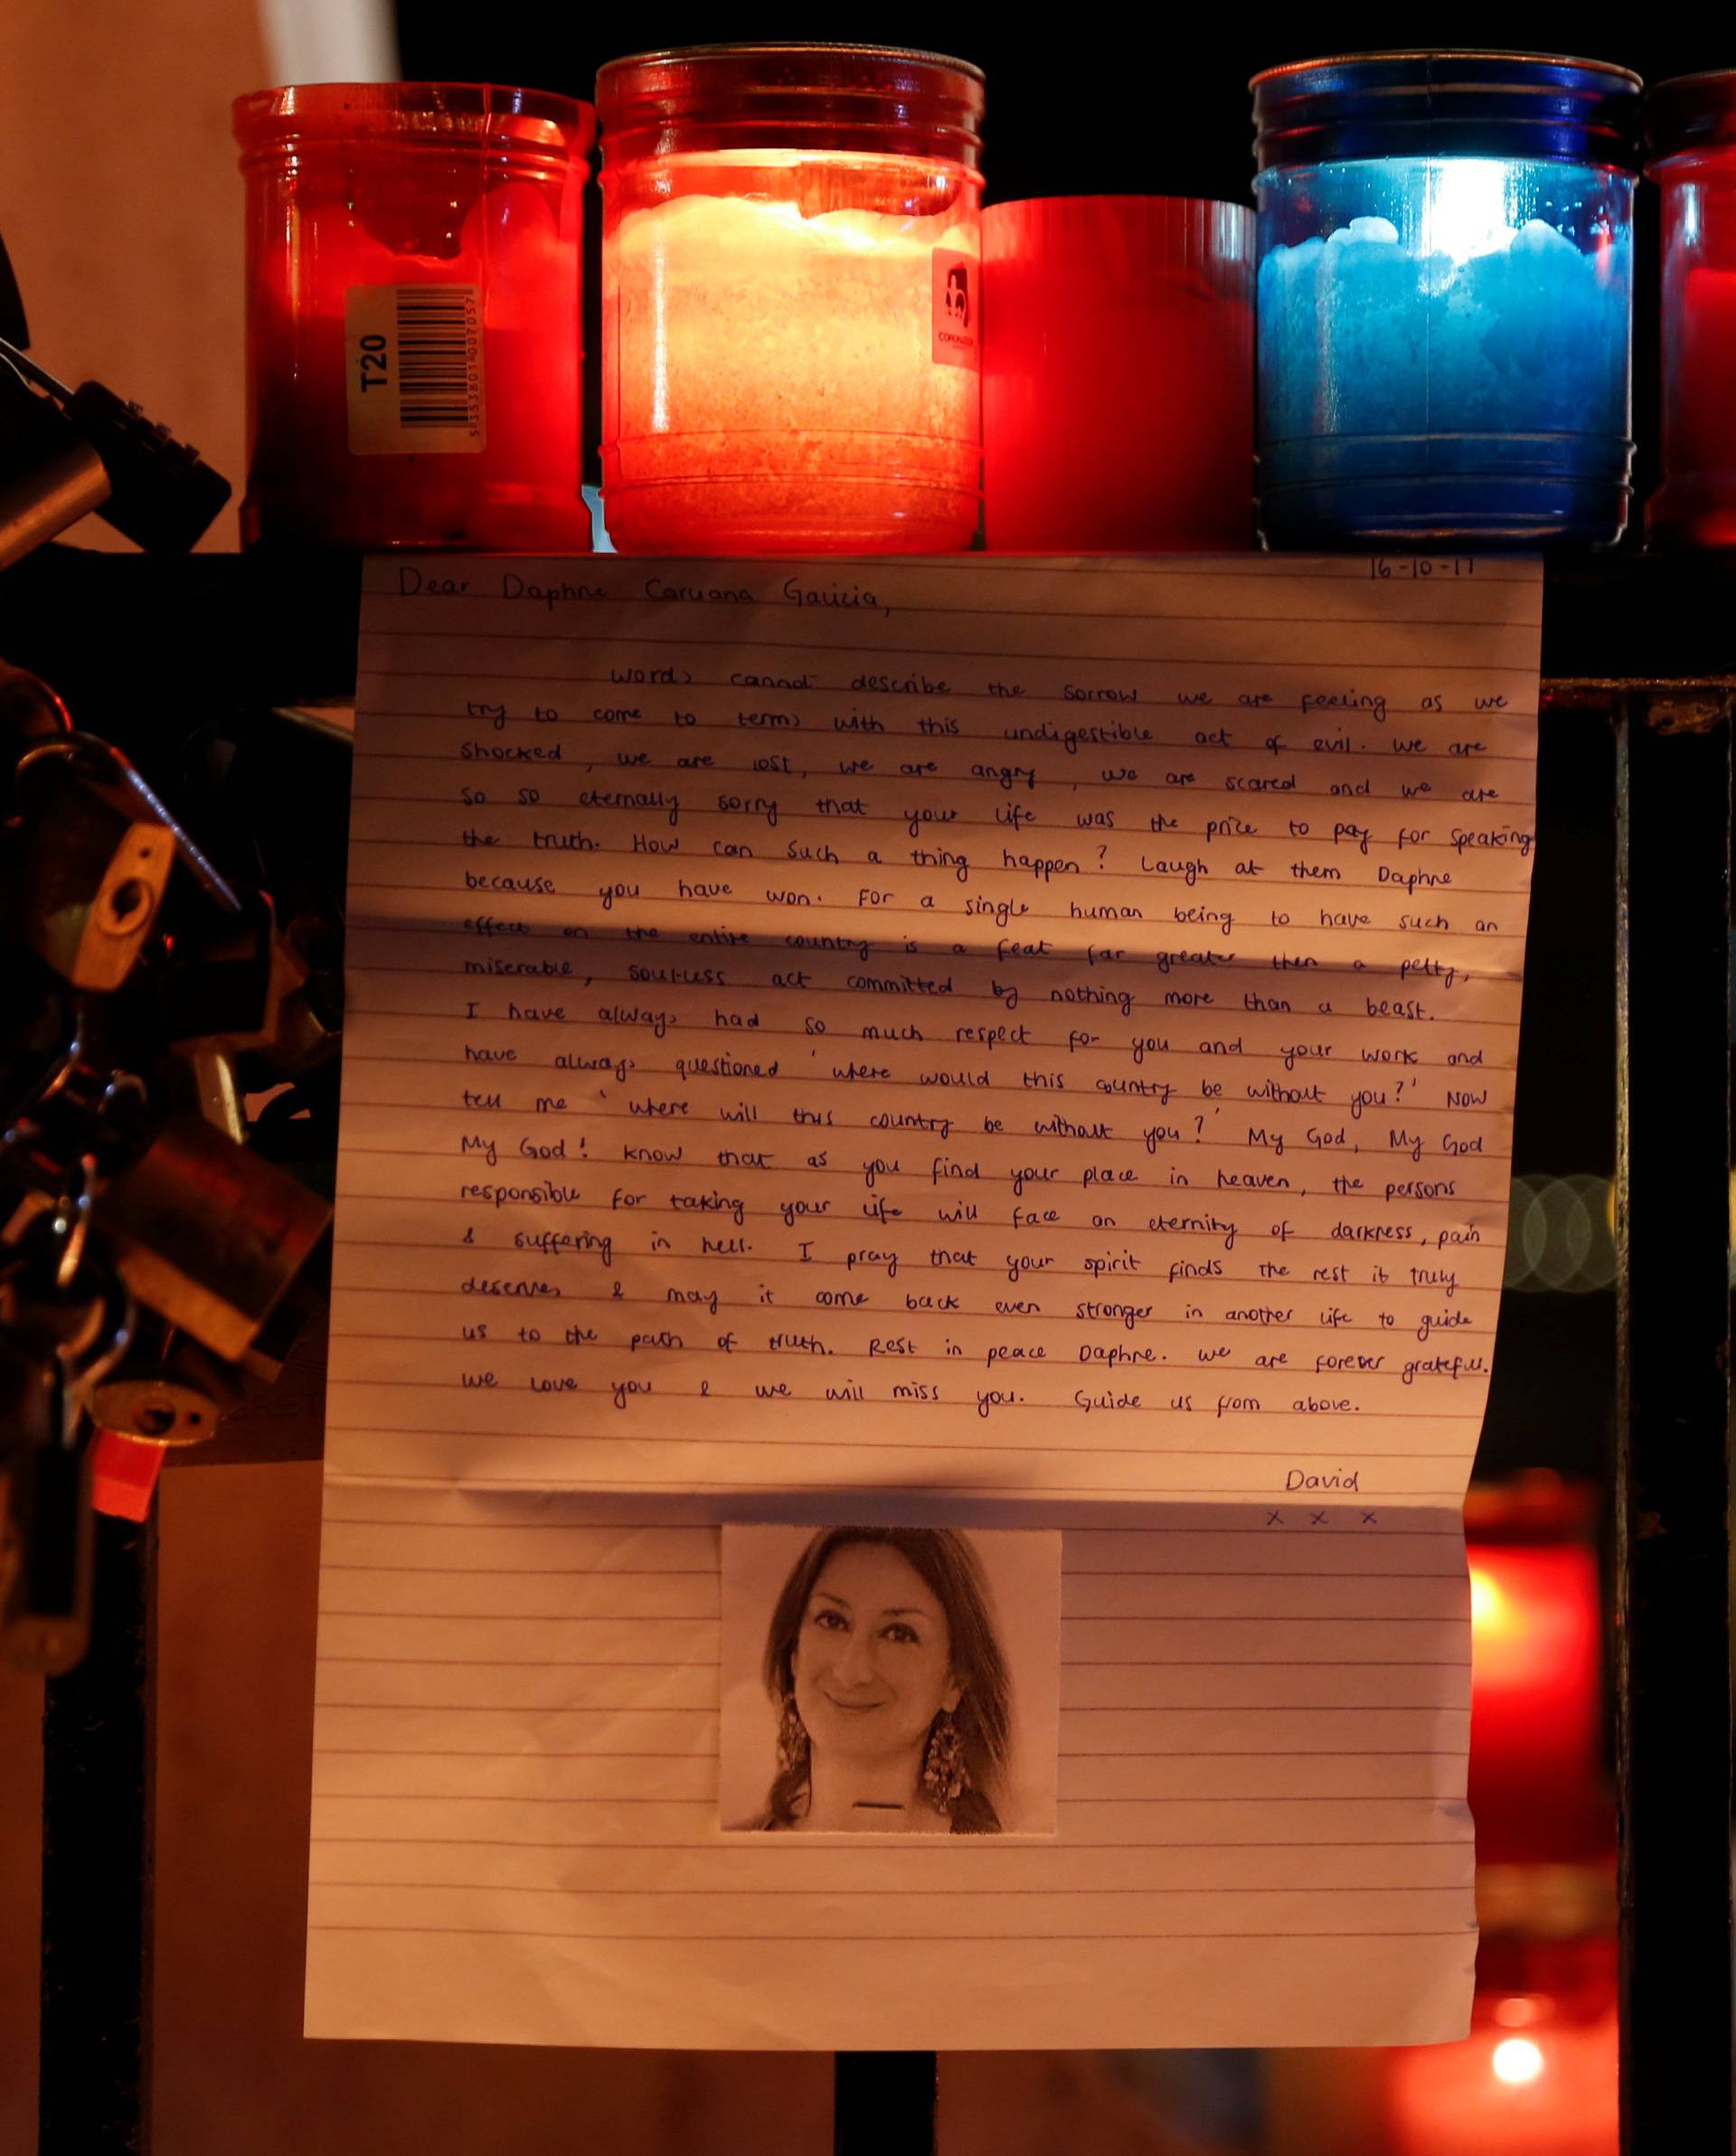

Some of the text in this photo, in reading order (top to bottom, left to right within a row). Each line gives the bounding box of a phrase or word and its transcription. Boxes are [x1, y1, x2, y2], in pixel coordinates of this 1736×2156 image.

[359, 334, 388, 392] T20
[399, 567, 468, 597] Dear
[851, 675, 951, 695] describe
[987, 683, 1024, 698] the
[1063, 684, 1137, 702] sorrow
[1301, 693, 1386, 722] feeling
[1421, 695, 1442, 713] as
[1475, 695, 1507, 710] we
[467, 701, 507, 731] try
[593, 708, 642, 723] come
[834, 707, 884, 732] with
[918, 717, 959, 735] this
[1004, 722, 1153, 755] undigestible
[1194, 728, 1230, 748] act
[971, 765, 1370, 796] angry scared and
[461, 787, 486, 806] so
[579, 790, 679, 826] eternally
[718, 796, 778, 827] sorry
[816, 798, 865, 815] that
[904, 809, 958, 838] your
[1077, 810, 1115, 828] was
[1334, 823, 1369, 855] pay
[712, 841, 753, 859] can
[788, 841, 839, 865] such
[910, 850, 969, 883] thing
[1003, 849, 1080, 883] happen
[1141, 855, 1209, 887] Laugh
[1235, 860, 1263, 876] at
[1290, 861, 1341, 880] them
[465, 871, 555, 894] because
[599, 883, 639, 911] you
[678, 880, 732, 898] have
[965, 896, 1029, 927] single
[1070, 901, 1143, 919] human
[1174, 906, 1235, 936] being
[1320, 909, 1368, 927] have
[1399, 915, 1448, 930] such
[1476, 921, 1498, 932] an
[689, 930, 749, 946] entire
[785, 936, 870, 962] country
[997, 940, 1049, 962] feat
[1088, 946, 1125, 966] far
[772, 971, 811, 989] act
[846, 970, 953, 993] committed
[1051, 986, 1135, 1017] nothing
[1165, 992, 1213, 1006] more
[1243, 993, 1291, 1012] than
[509, 1003, 565, 1021] have
[715, 1009, 760, 1028] had
[862, 1021, 924, 1042] much
[956, 1024, 1029, 1051] respect
[1069, 1031, 1099, 1053] for
[1131, 1034, 1169, 1065] you
[1280, 1044, 1332, 1071] your
[1362, 1045, 1418, 1065] work
[465, 1045, 514, 1061] have
[675, 1052, 778, 1081] questioned
[920, 1067, 990, 1086] would
[1023, 1072, 1064, 1089] this
[1096, 1079, 1177, 1106] country
[1247, 1078, 1325, 1104] without
[720, 1102, 757, 1122] will
[870, 1113, 954, 1140] country
[1034, 1114, 1113, 1140] without
[1389, 1129, 1425, 1163] My
[1442, 1134, 1482, 1156] God
[461, 1136, 1455, 1202] My that as you find your place the persons
[669, 1191, 744, 1226] taking
[780, 1200, 831, 1227] your
[1013, 1207, 1060, 1229] face
[1149, 1214, 1238, 1251] eternity
[1438, 1224, 1480, 1250] pain
[514, 1232, 612, 1266] suffering
[846, 1249, 898, 1278] pray
[930, 1249, 976, 1266] that
[1084, 1249, 1139, 1279] spirit
[1168, 1259, 1222, 1284] finds
[1313, 1265, 1346, 1282] rest
[1410, 1267, 1458, 1297] truly
[667, 1288, 718, 1315] may
[816, 1291, 869, 1306] come
[906, 1294, 959, 1310] back
[995, 1301, 1041, 1314] even
[1076, 1302, 1153, 1331] stronger
[1225, 1308, 1293, 1326] another
[1417, 1309, 1471, 1342] guide
[630, 1332, 684, 1352] path
[986, 1346, 1044, 1369] peace
[1255, 1353, 1287, 1369] are
[611, 1381, 1359, 1418] you we will miss you. Guide us from above.
[1286, 1471, 1358, 1492] David
